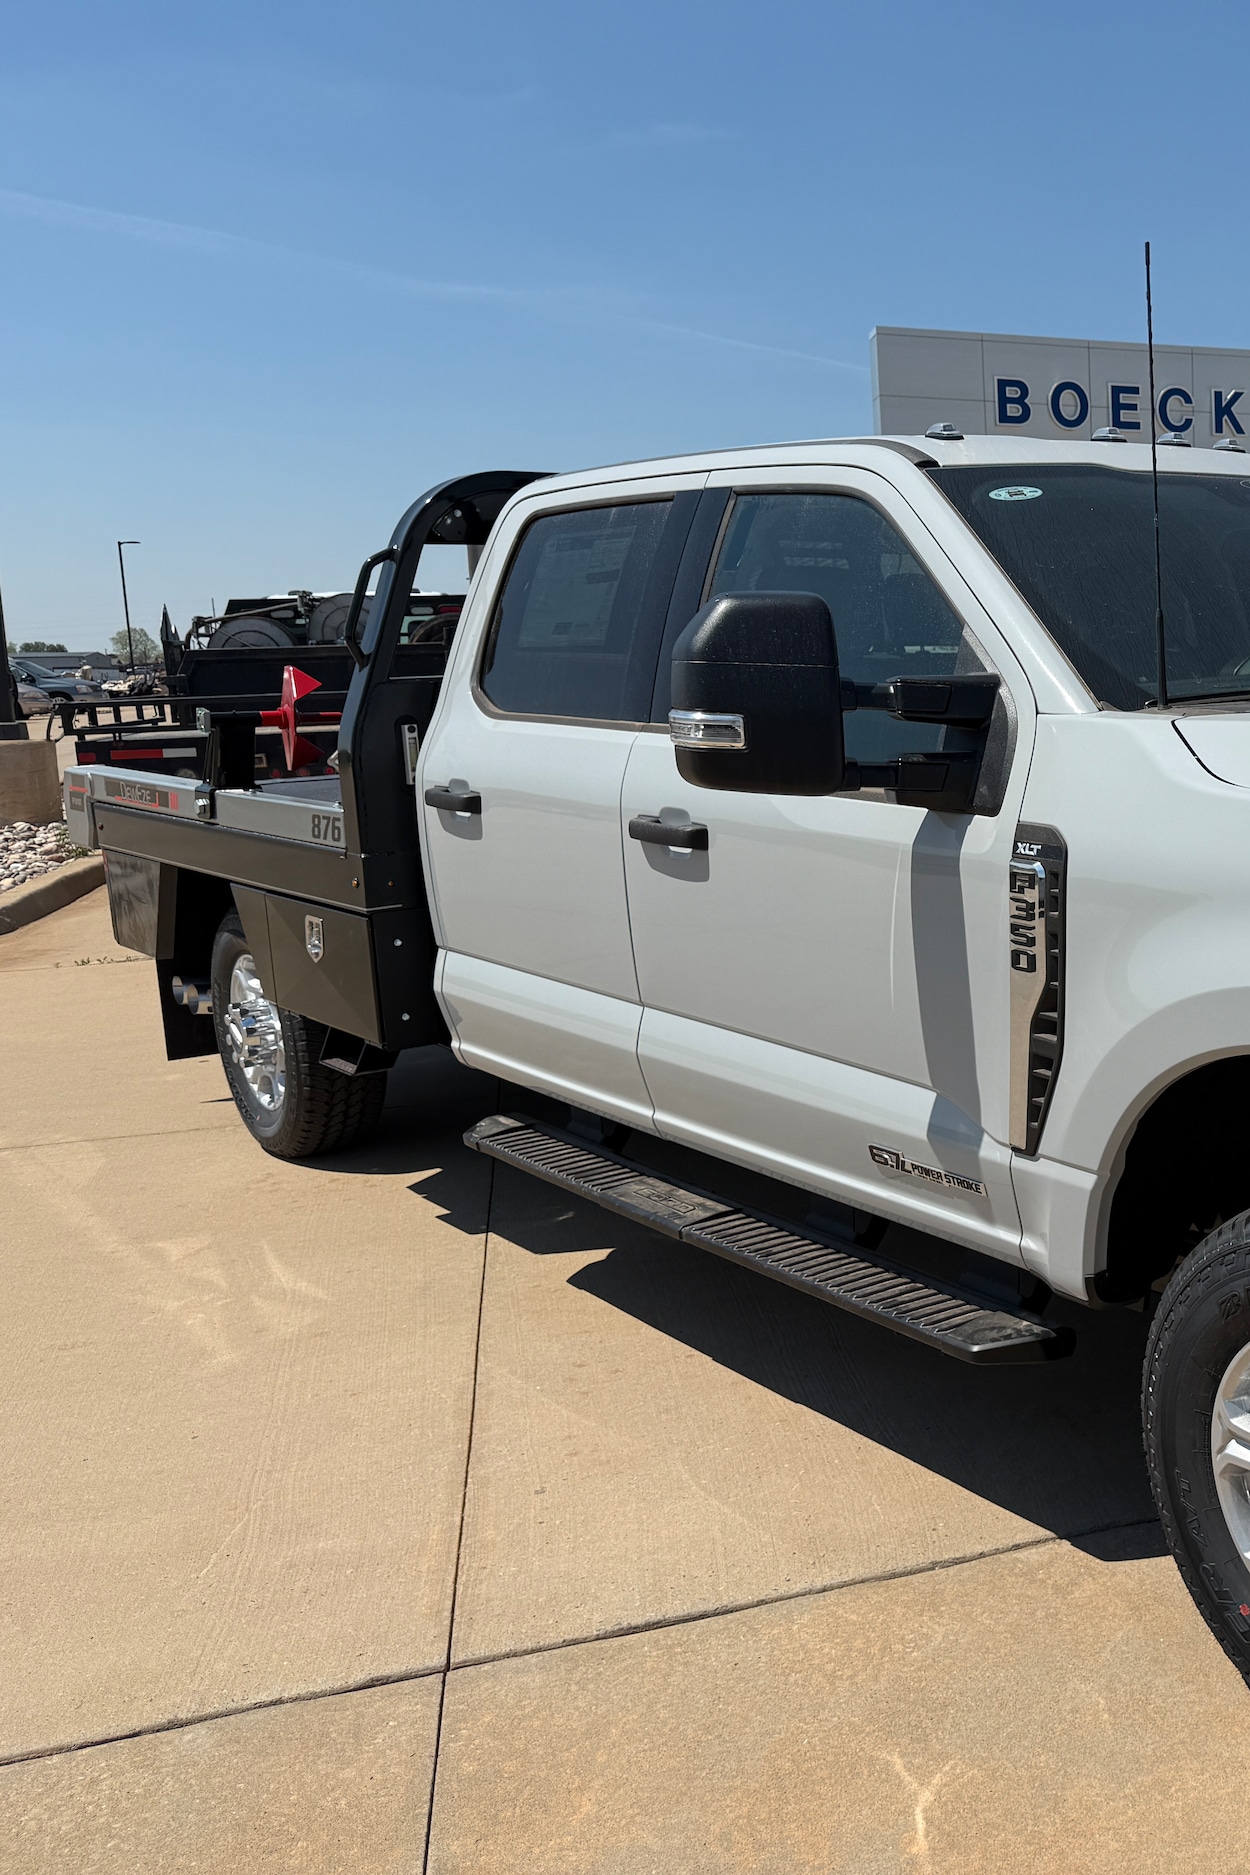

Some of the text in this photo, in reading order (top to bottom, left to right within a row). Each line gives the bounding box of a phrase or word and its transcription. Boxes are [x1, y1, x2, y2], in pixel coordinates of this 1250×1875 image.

[311, 814, 342, 842] 876
[1015, 842, 1042, 856] XLT
[911, 1163, 944, 1181] POWER
[943, 1175, 984, 1195] STROKE
